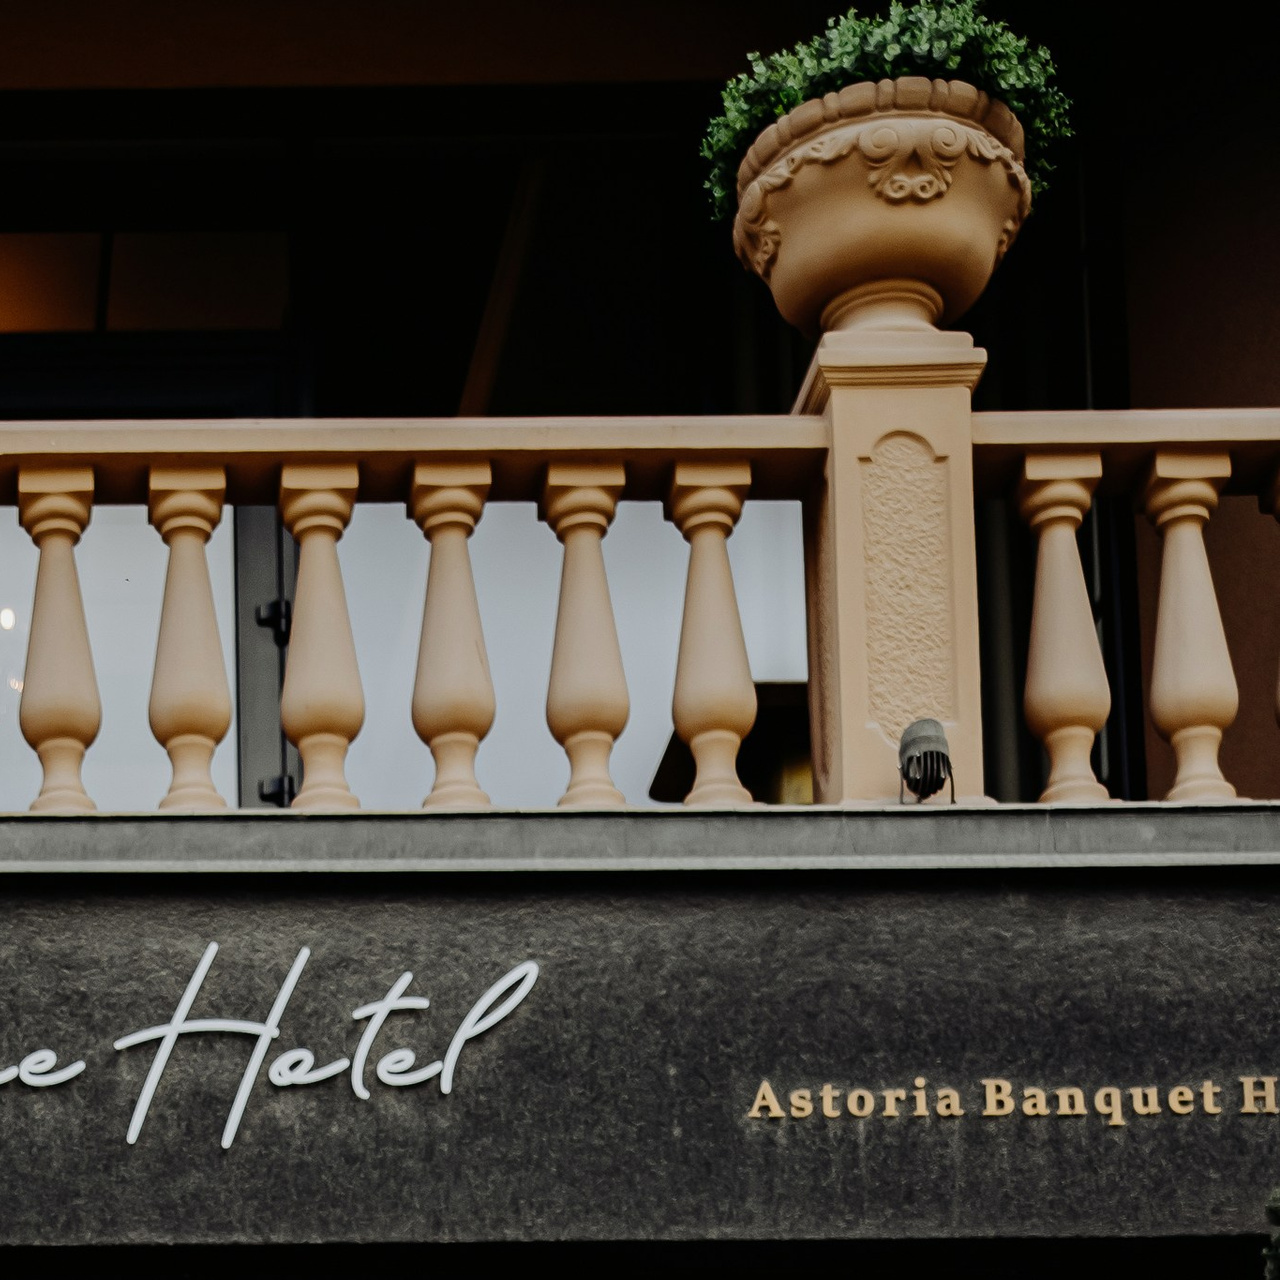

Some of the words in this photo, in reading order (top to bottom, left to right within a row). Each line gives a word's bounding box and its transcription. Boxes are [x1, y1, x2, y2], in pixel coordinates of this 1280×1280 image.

[113, 940, 540, 1149] Hotel
[747, 1077, 965, 1118] Astoria
[981, 1078, 1222, 1126] Banquet
